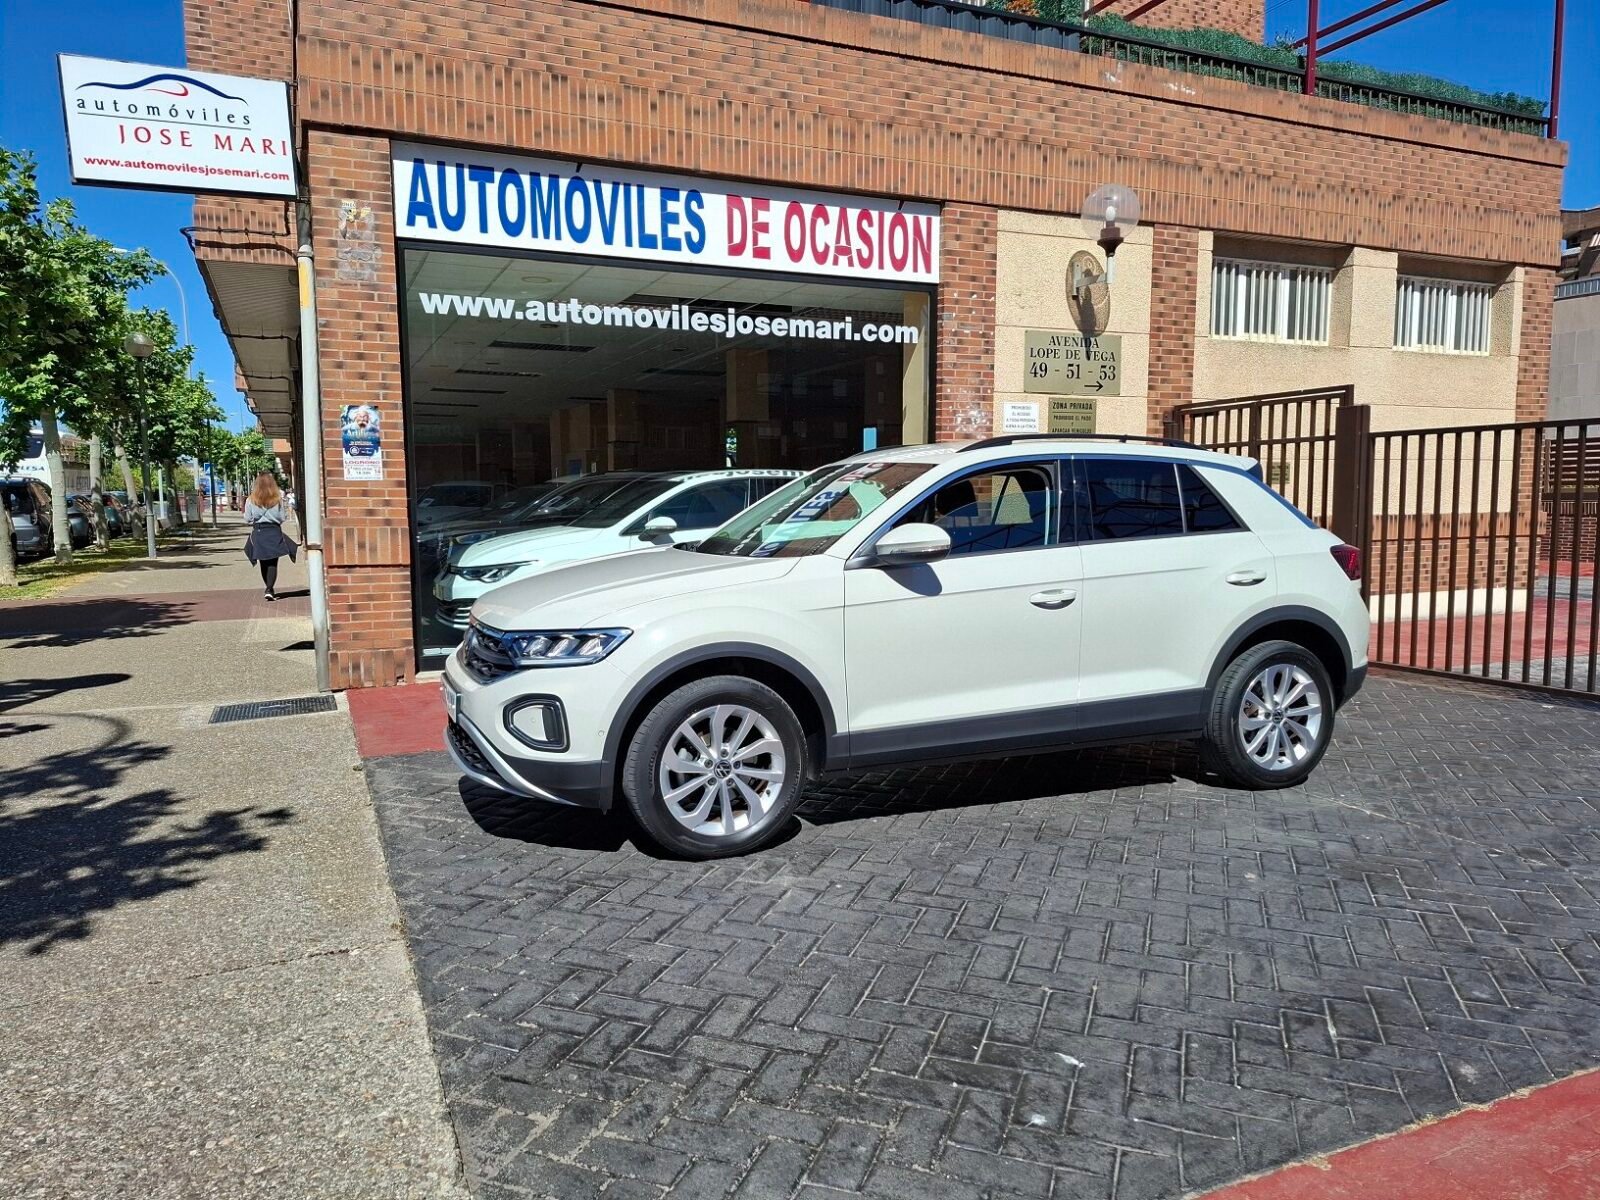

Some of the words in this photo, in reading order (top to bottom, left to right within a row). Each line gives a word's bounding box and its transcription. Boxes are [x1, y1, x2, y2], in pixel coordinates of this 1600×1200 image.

[76, 97, 251, 125] automóviles
[118, 124, 193, 148] JOSE
[214, 133, 288, 156] MARI
[84, 156, 290, 181] www.automovilesjosemari.com
[406, 157, 707, 255] AUTOMÓVILES
[725, 194, 772, 261] DE
[783, 199, 934, 275] OCASIÓN
[418, 292, 920, 345] www.automovilesjosemari.com
[1048, 335, 1100, 348] AVENIDA
[1029, 347, 1061, 359] LOPE
[1065, 349, 1081, 360] DE
[1086, 350, 1116, 362] VEGA
[1029, 362, 1048, 378] 49
[1066, 363, 1080, 380] 51
[1099, 364, 1116, 381] 53
[1052, 401, 1068, 410] ZONA
[1069, 402, 1093, 411] PRIVADA
